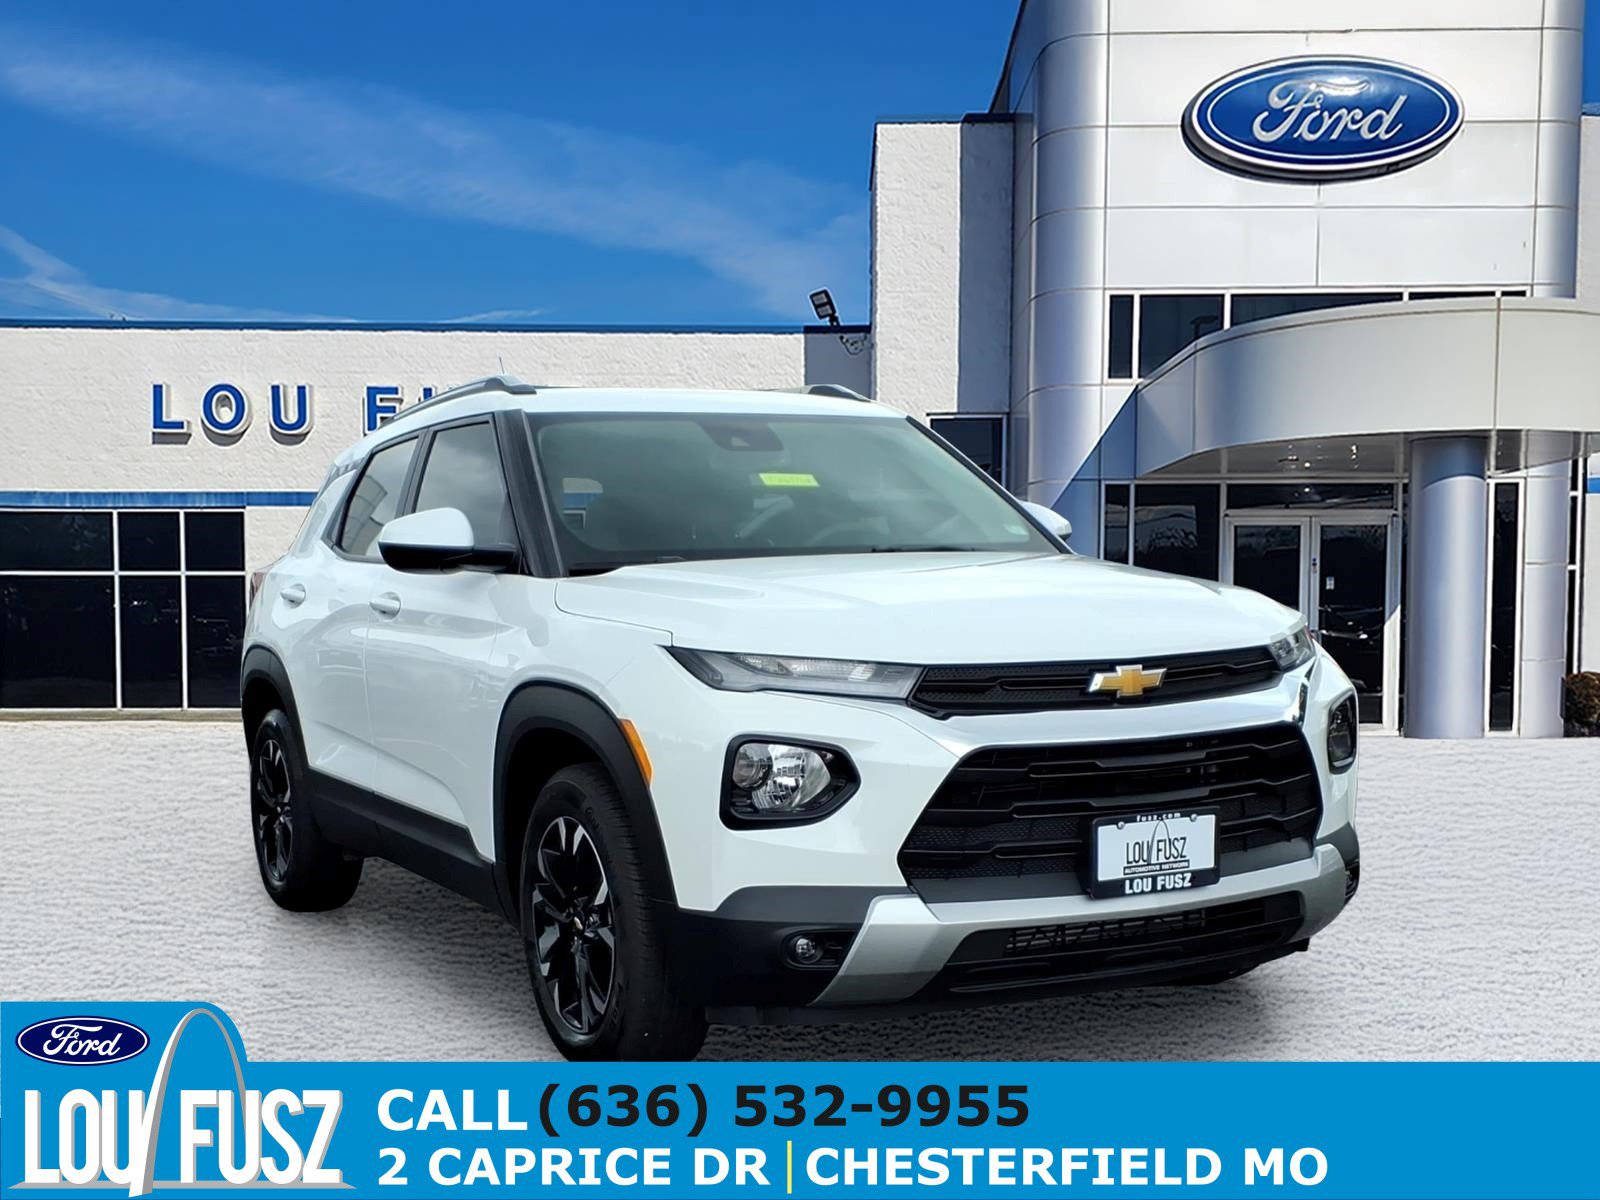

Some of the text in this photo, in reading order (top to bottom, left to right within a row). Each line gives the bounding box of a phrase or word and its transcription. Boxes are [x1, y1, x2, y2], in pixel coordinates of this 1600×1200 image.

[1252, 77, 1408, 142] Ford
[151, 383, 311, 435] LOU
[1126, 836, 1187, 865] LOU FUSZ
[1124, 872, 1192, 894] LOU FUSZ
